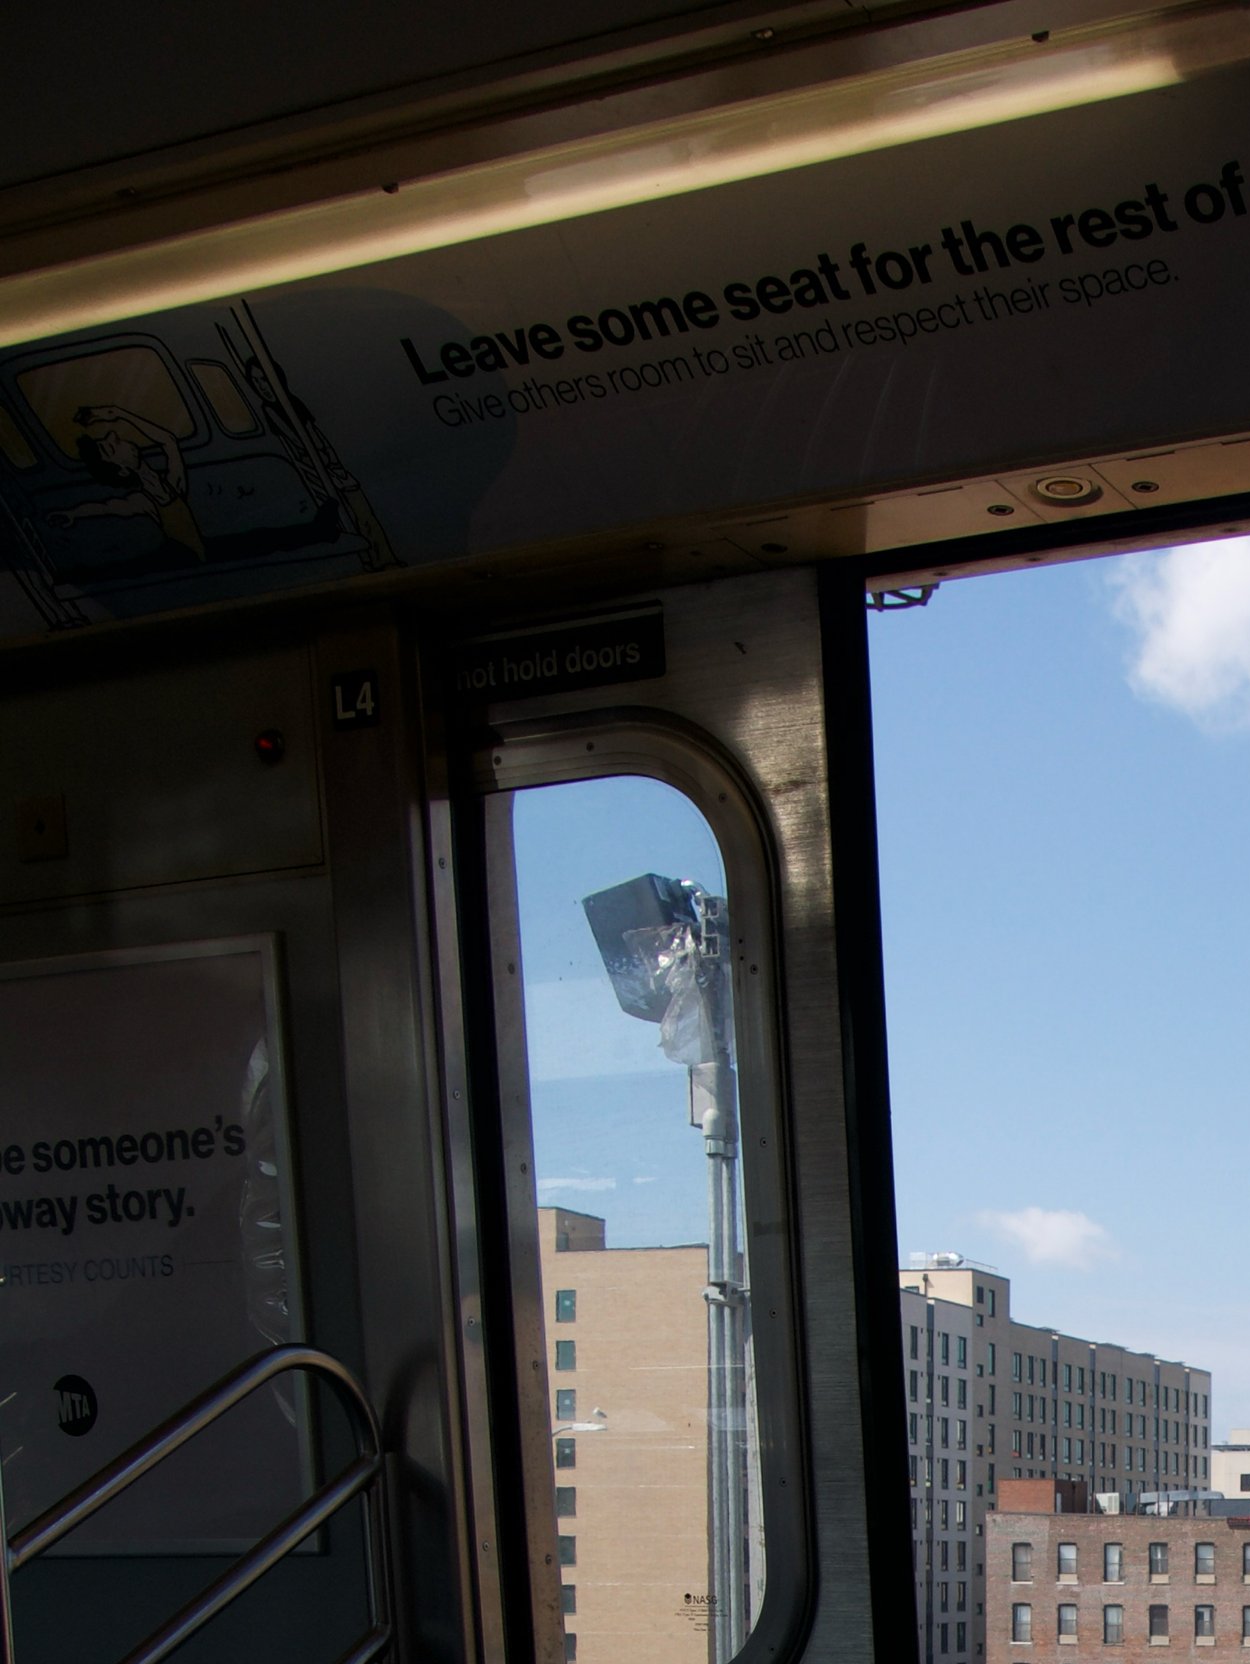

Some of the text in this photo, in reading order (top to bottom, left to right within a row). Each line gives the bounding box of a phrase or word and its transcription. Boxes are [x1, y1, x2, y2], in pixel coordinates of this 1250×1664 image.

[400, 323, 565, 385] Leave
[568, 291, 719, 352] some
[724, 254, 851, 320] seat
[850, 243, 933, 295] for
[941, 221, 1045, 276] the
[1051, 184, 1178, 254] rest
[1185, 161, 1247, 223] of
[433, 260, 1179, 428] Give others room to sit and respect their space.
[457, 641, 641, 692] not hold doors
[334, 681, 375, 720] L4
[0, 1115, 246, 1175] e someone's
[0, 1184, 195, 1235] way story.
[3, 1254, 174, 1287] RTESY COUNTS
[693, 1595, 717, 1604] NASG
